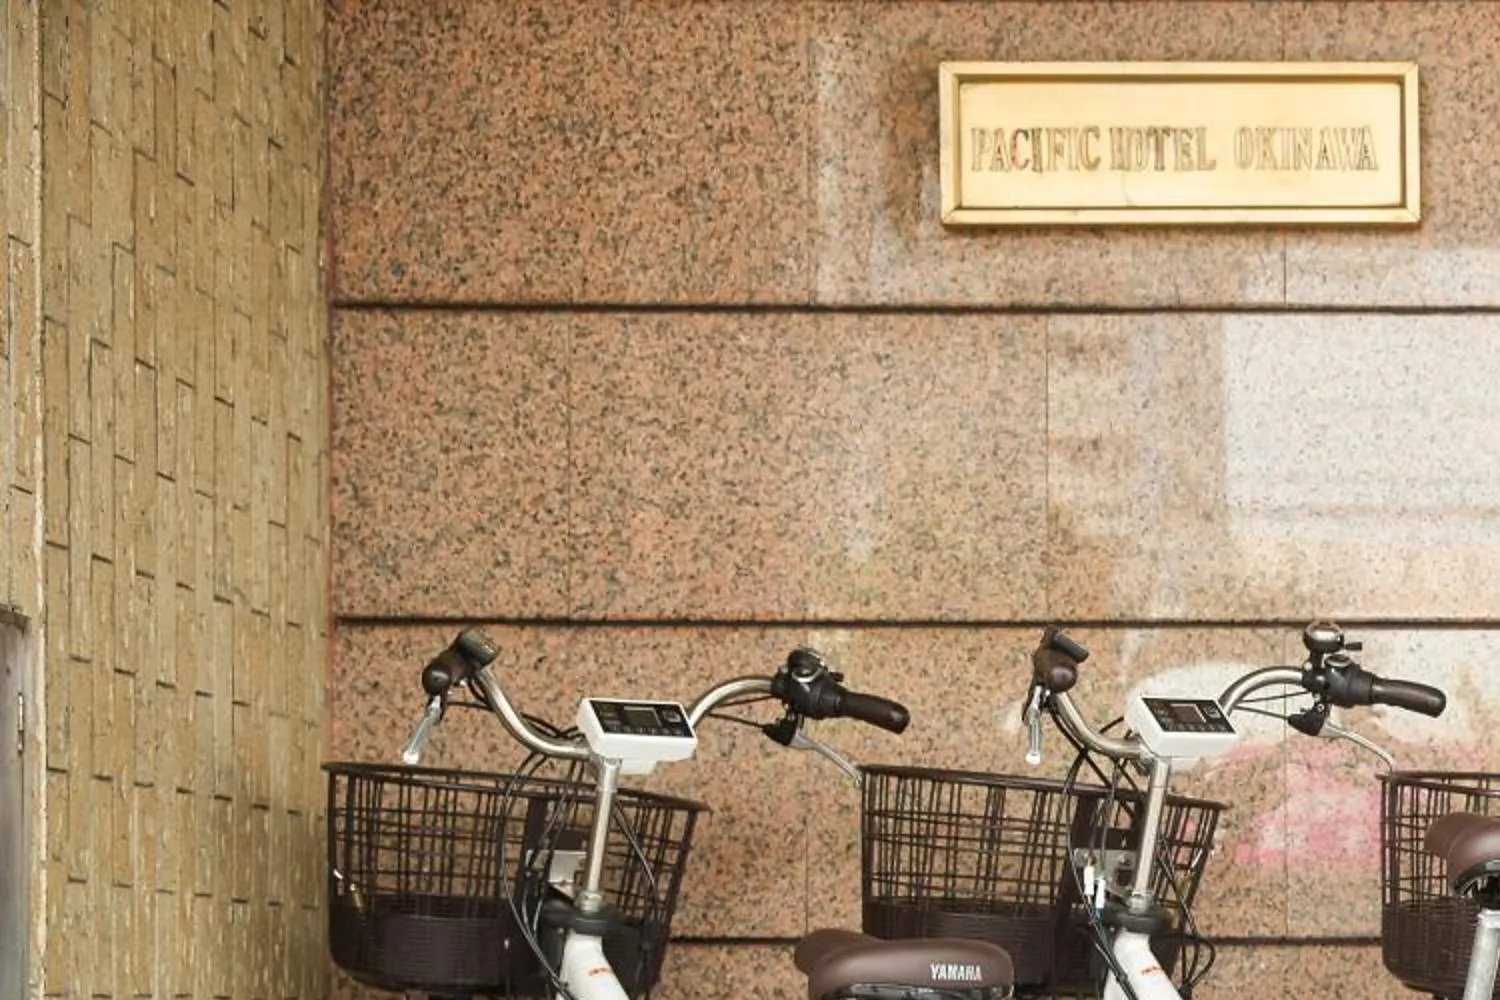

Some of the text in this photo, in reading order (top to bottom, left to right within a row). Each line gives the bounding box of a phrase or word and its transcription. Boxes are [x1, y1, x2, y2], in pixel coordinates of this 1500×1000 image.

[970, 123, 1379, 173] PACIFIC HOTEL OKINAWA
[930, 962, 983, 982] YAMAHA
